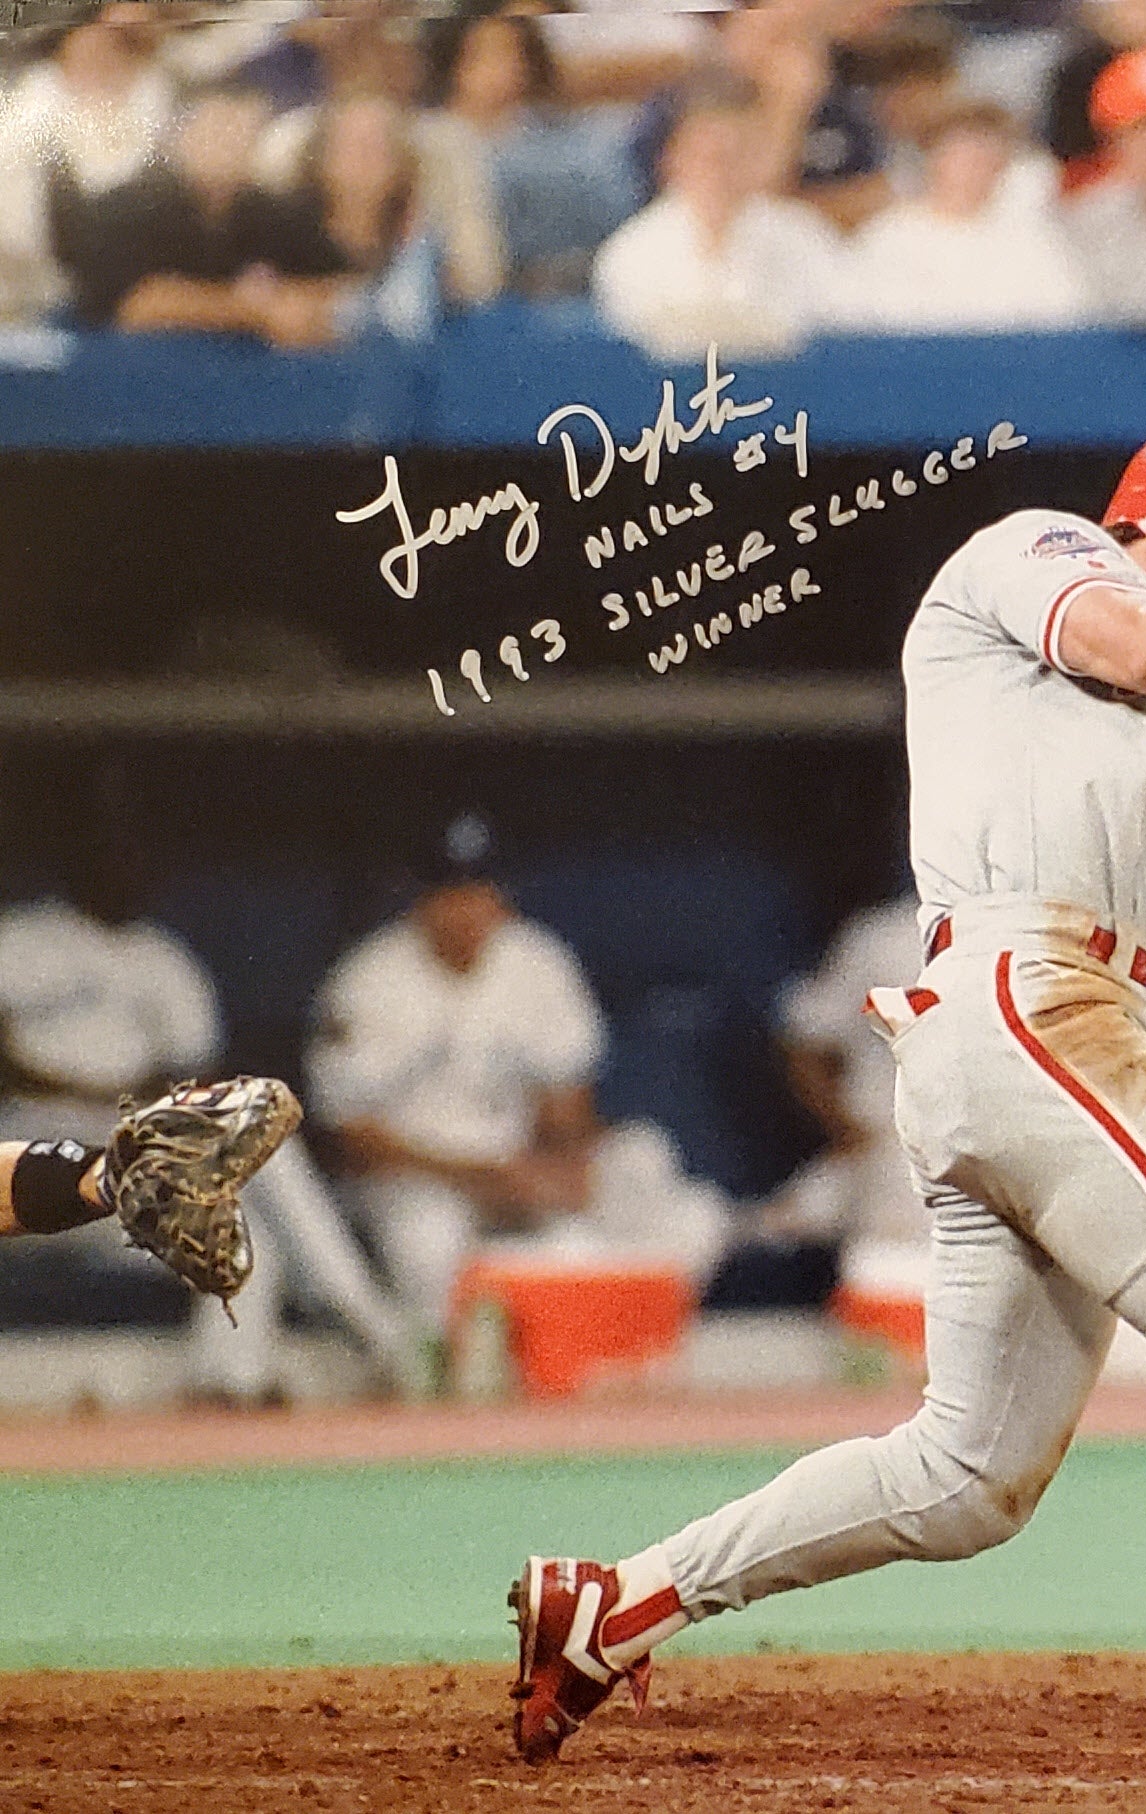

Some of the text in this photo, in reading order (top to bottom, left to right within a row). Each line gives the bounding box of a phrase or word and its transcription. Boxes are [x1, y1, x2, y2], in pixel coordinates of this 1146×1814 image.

[427, 420, 1029, 718] 1993 SILVER SLUGGER
[584, 410, 809, 569] NAILS #4
[648, 568, 822, 675] WINNER
